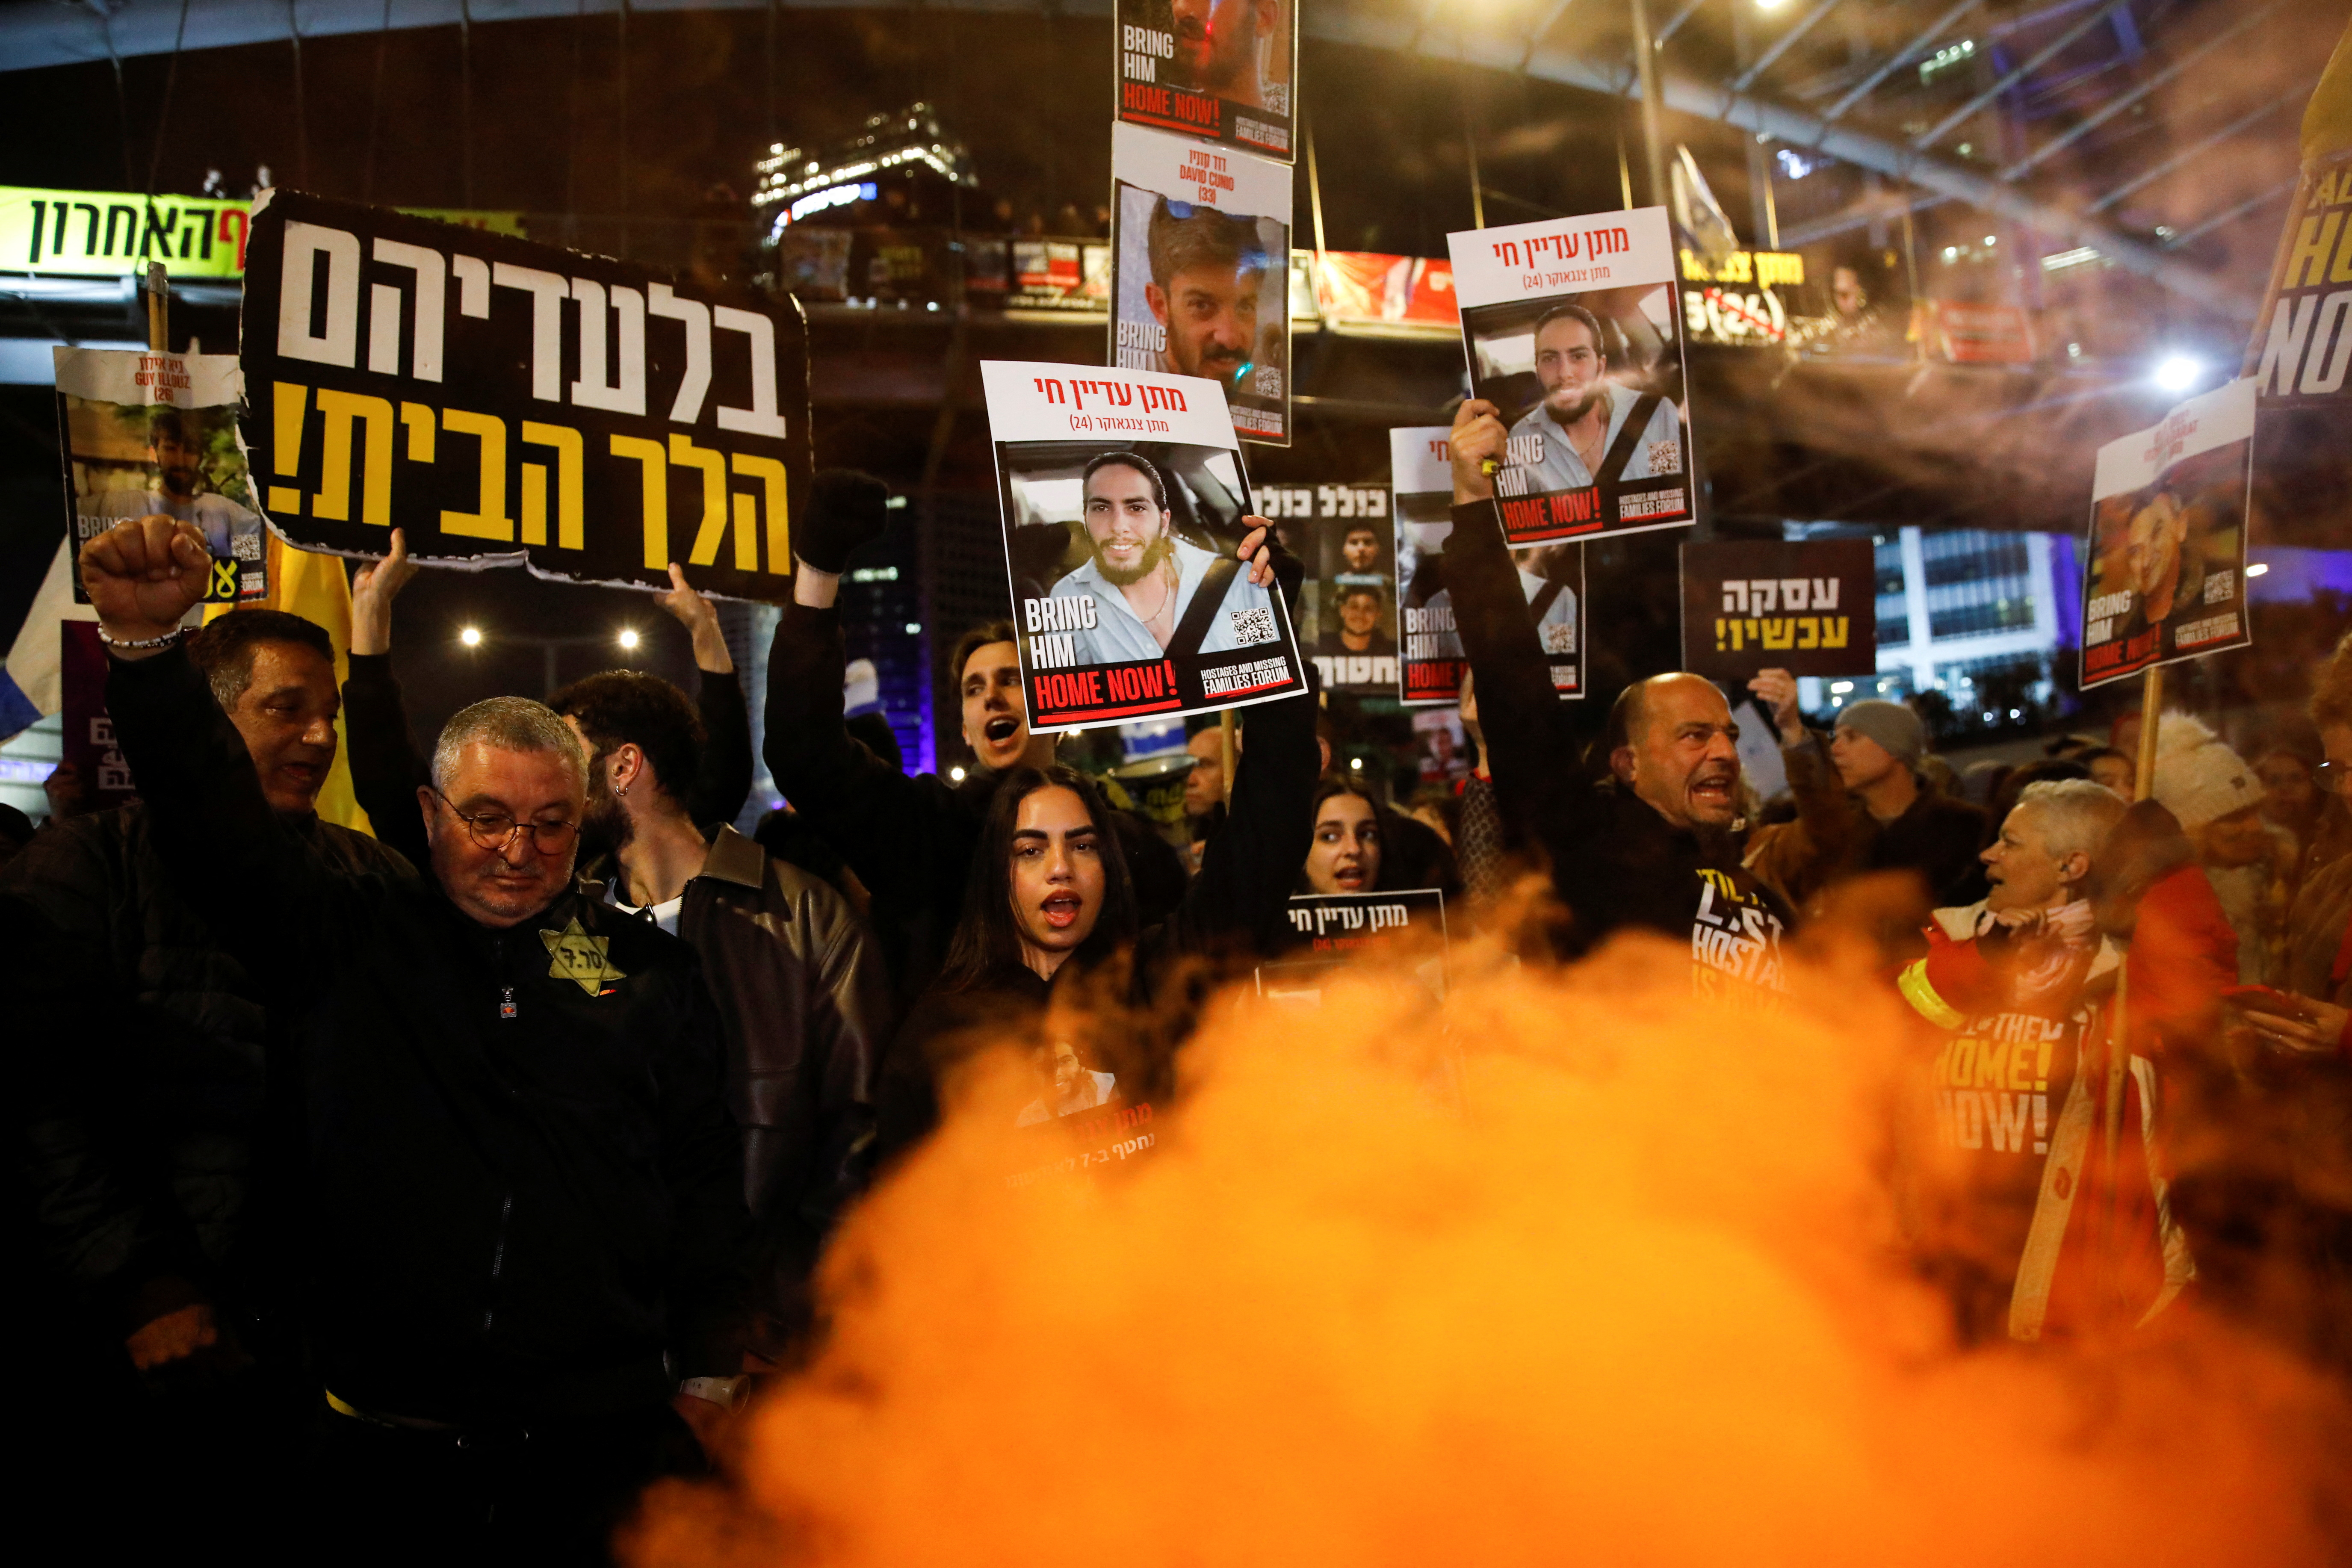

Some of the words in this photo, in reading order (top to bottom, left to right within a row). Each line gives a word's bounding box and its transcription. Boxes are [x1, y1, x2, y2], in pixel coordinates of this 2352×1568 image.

[1124, 25, 1173, 59] BRING
[1124, 52, 1155, 83] HIM
[1124, 83, 1170, 116] HOME
[1175, 93, 1220, 127] NOW!
[1189, 149, 1210, 168] קוניו
[1213, 155, 1226, 172] דוד
[1180, 164, 1206, 184] DAVID
[1209, 171, 1234, 191] CUNIO
[1199, 185, 1216, 205] (33)
[29, 201, 216, 263] האחרון
[1584, 227, 1630, 261] מתן
[1492, 241, 1519, 267] חי
[1524, 232, 1580, 269] עדיין
[1523, 273, 1543, 291] (24)
[1545, 269, 1587, 287] צנגאוקר
[1590, 266, 1611, 283] מתן
[277, 219, 786, 439] בלעדיהם
[1117, 319, 1167, 352] BRING
[135, 372, 155, 386] GUY
[158, 372, 191, 389] ILLOUZ
[154, 386, 174, 403] (26)
[1034, 378, 1065, 404] חי
[1069, 378, 1132, 410] עדיין
[1137, 384, 1188, 414] מתן
[1070, 414, 1093, 431] (24)
[1095, 416, 1143, 431] צנגאוקר
[1147, 419, 1170, 433] מתן
[1429, 440, 1451, 461] חי
[268, 381, 584, 550] הבית!
[1496, 467, 1528, 498] HIM
[610, 432, 791, 576] הלך
[1318, 485, 1387, 517] כולל
[1502, 497, 1548, 530] HOME
[1550, 486, 1601, 525] NOW!
[1722, 577, 1840, 618] עסקה
[2087, 589, 2132, 623] BRING
[1025, 595, 1097, 633] BRING
[1406, 606, 1457, 633] BRING
[1715, 616, 1850, 652] עכשיו!
[2086, 617, 2114, 647] HIM
[1028, 633, 1076, 670] HIM
[1406, 634, 1439, 660] HIM
[1201, 666, 1238, 680] HOSTAGES
[1238, 662, 1253, 674] AND
[1253, 656, 1286, 672] MISSING
[1203, 674, 1251, 695] FAMILIES
[1252, 666, 1291, 688] FORUM
[1408, 663, 1454, 688] HOME
[1034, 671, 1104, 709] HOME
[1106, 659, 1178, 703] NOW!
[1287, 909, 1312, 931] חי
[1315, 906, 1364, 935] עדיין
[1367, 904, 1409, 933] מתן
[560, 946, 603, 969] 7.10
[1112, 1133, 1155, 1160] נחטף
